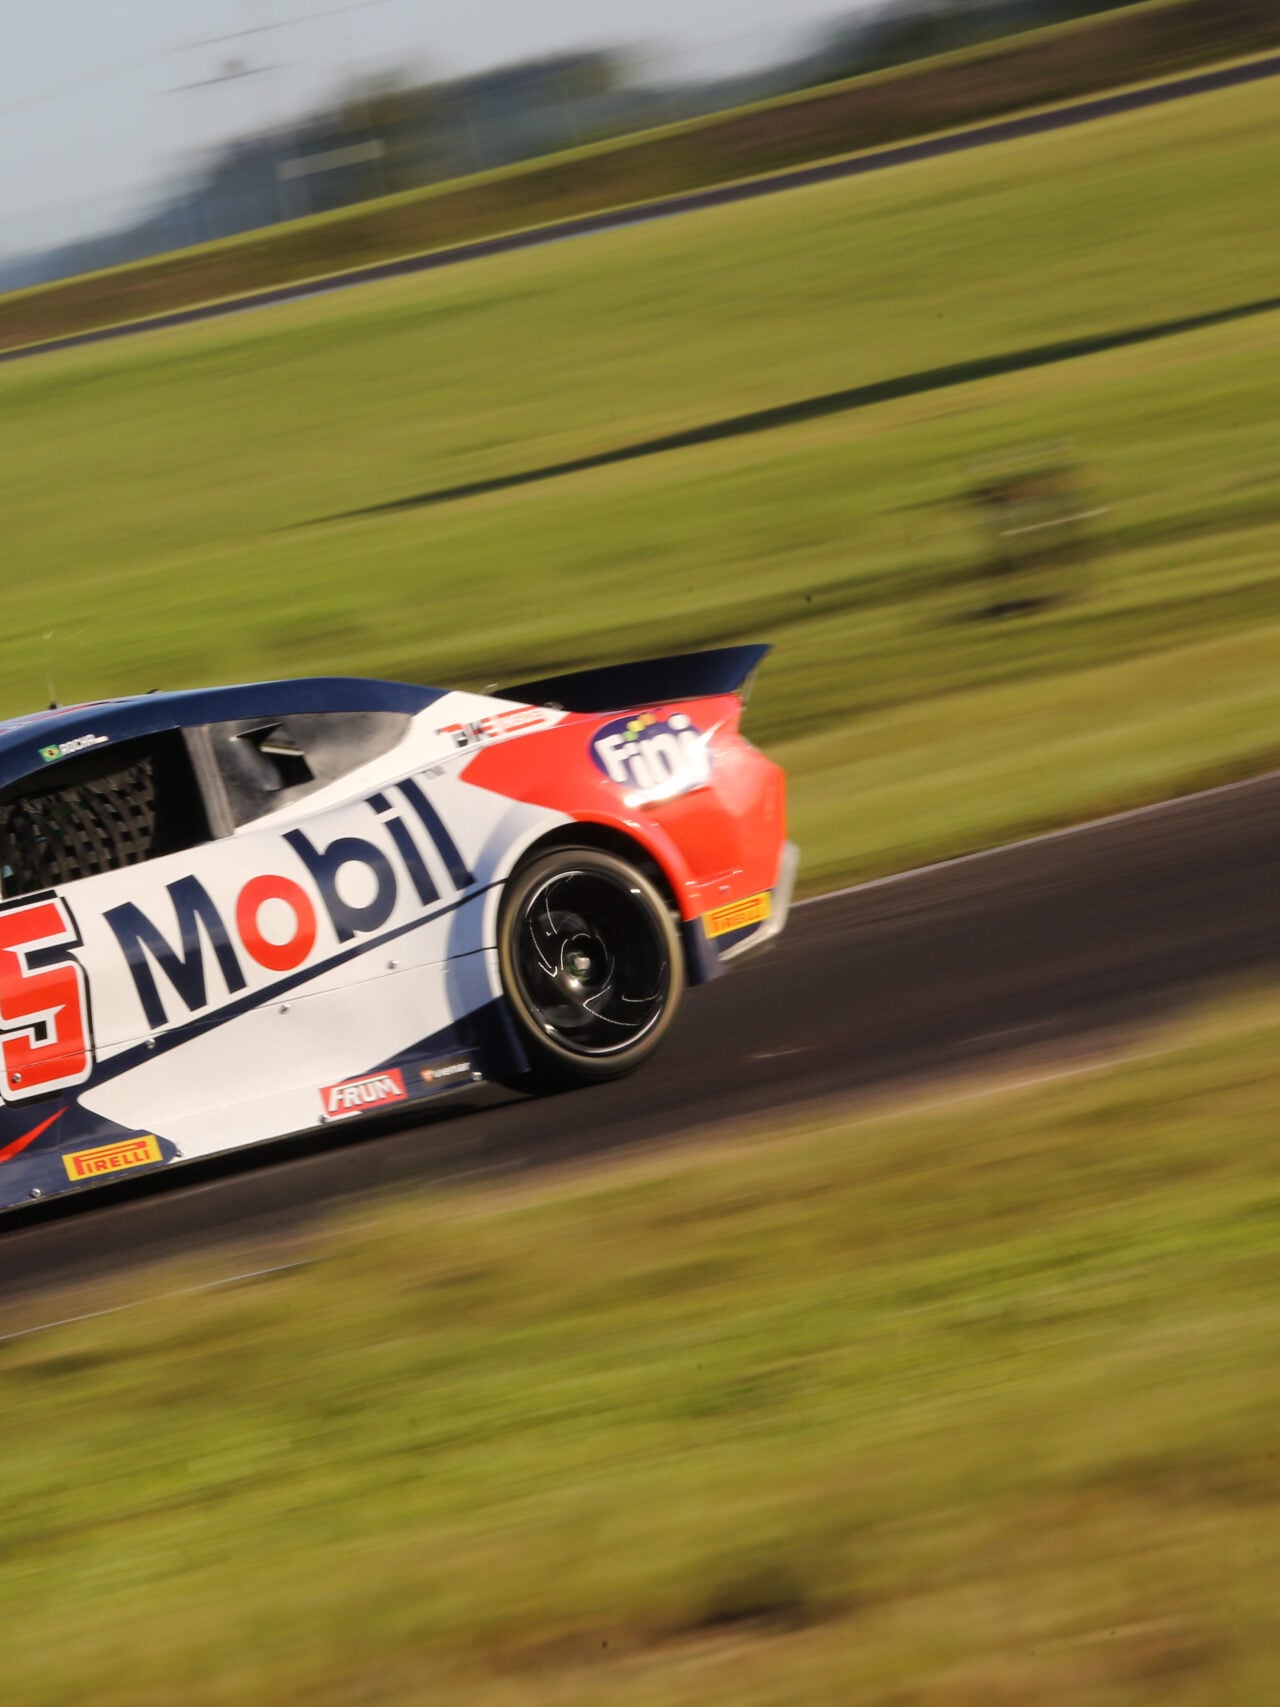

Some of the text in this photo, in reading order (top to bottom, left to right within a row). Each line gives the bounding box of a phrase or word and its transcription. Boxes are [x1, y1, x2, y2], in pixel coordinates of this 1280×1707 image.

[102, 778, 477, 1030] Mobil
[328, 1074, 403, 1113] FRUM
[72, 1140, 151, 1176] PIRELLI
